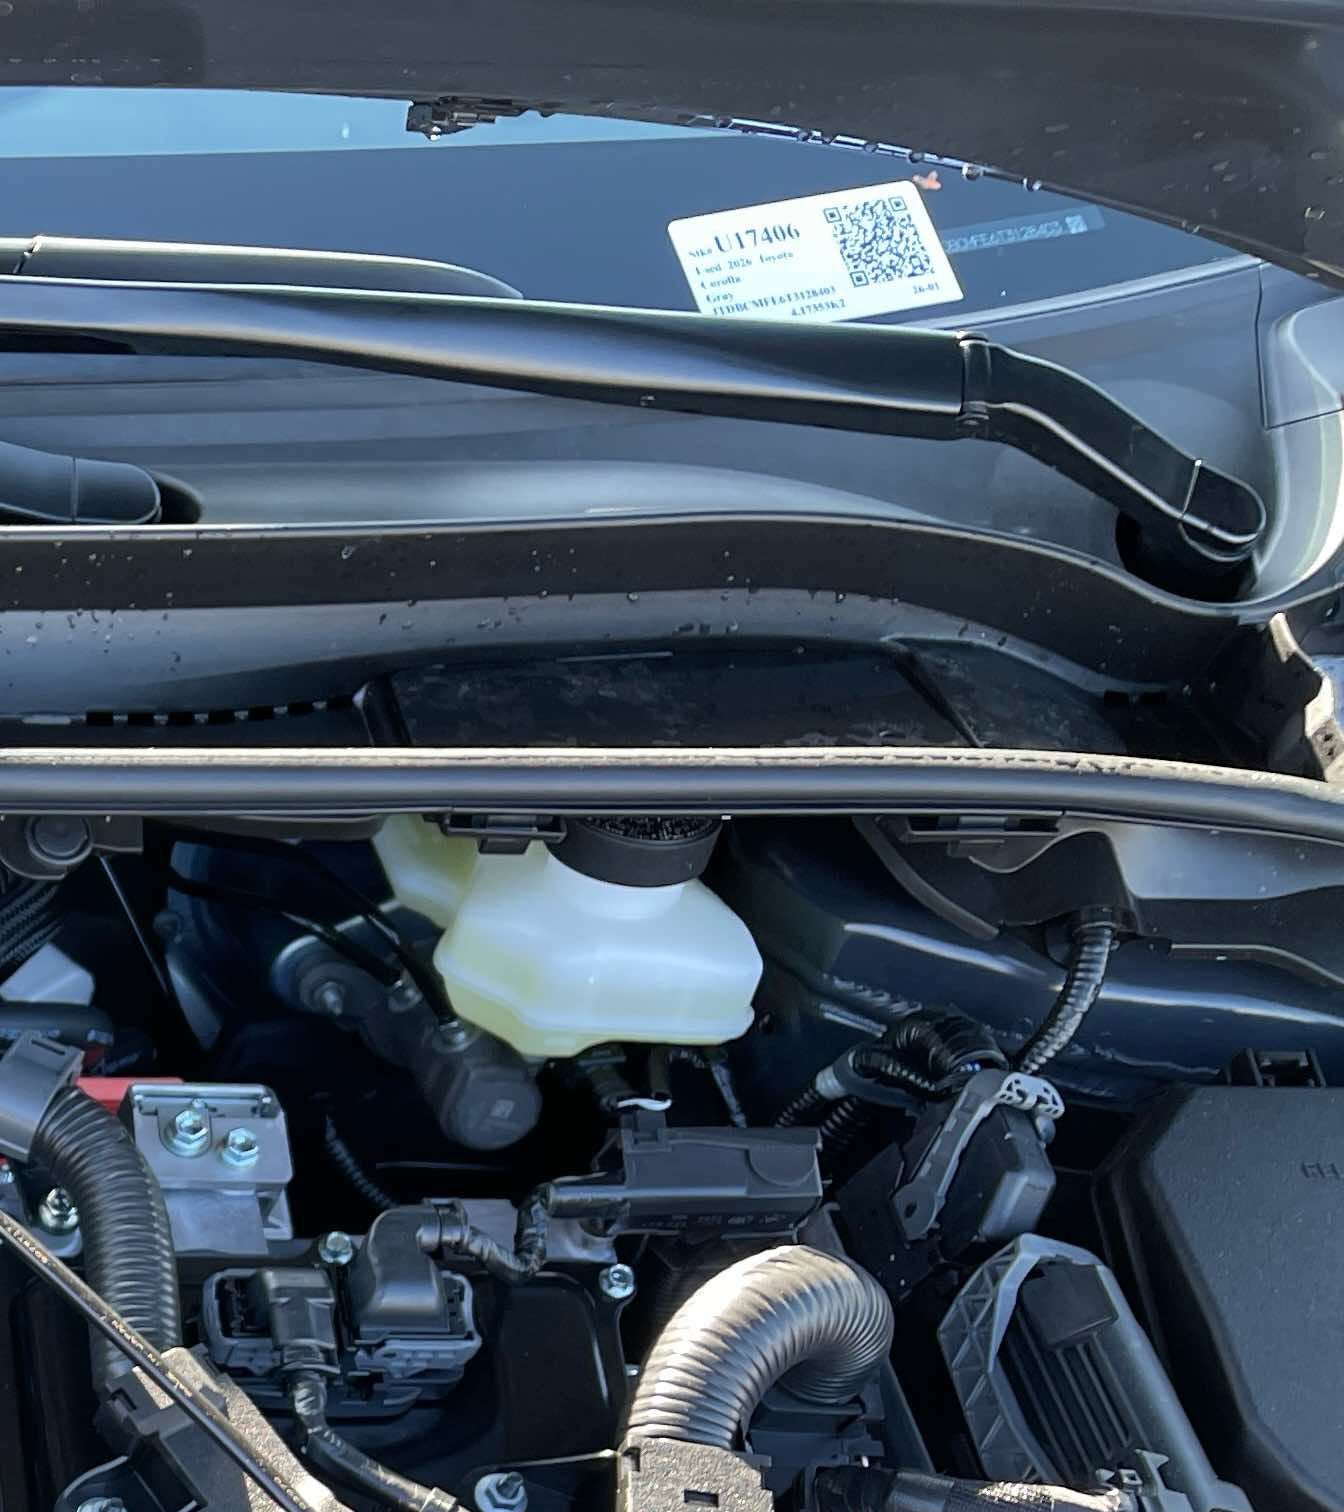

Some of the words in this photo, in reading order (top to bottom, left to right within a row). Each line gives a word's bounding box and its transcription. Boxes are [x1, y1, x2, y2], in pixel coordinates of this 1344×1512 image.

[714, 223, 800, 253] U17406
[728, 258, 752, 270] 2026
[759, 251, 794, 264] Toyota
[700, 276, 742, 289] Corolla
